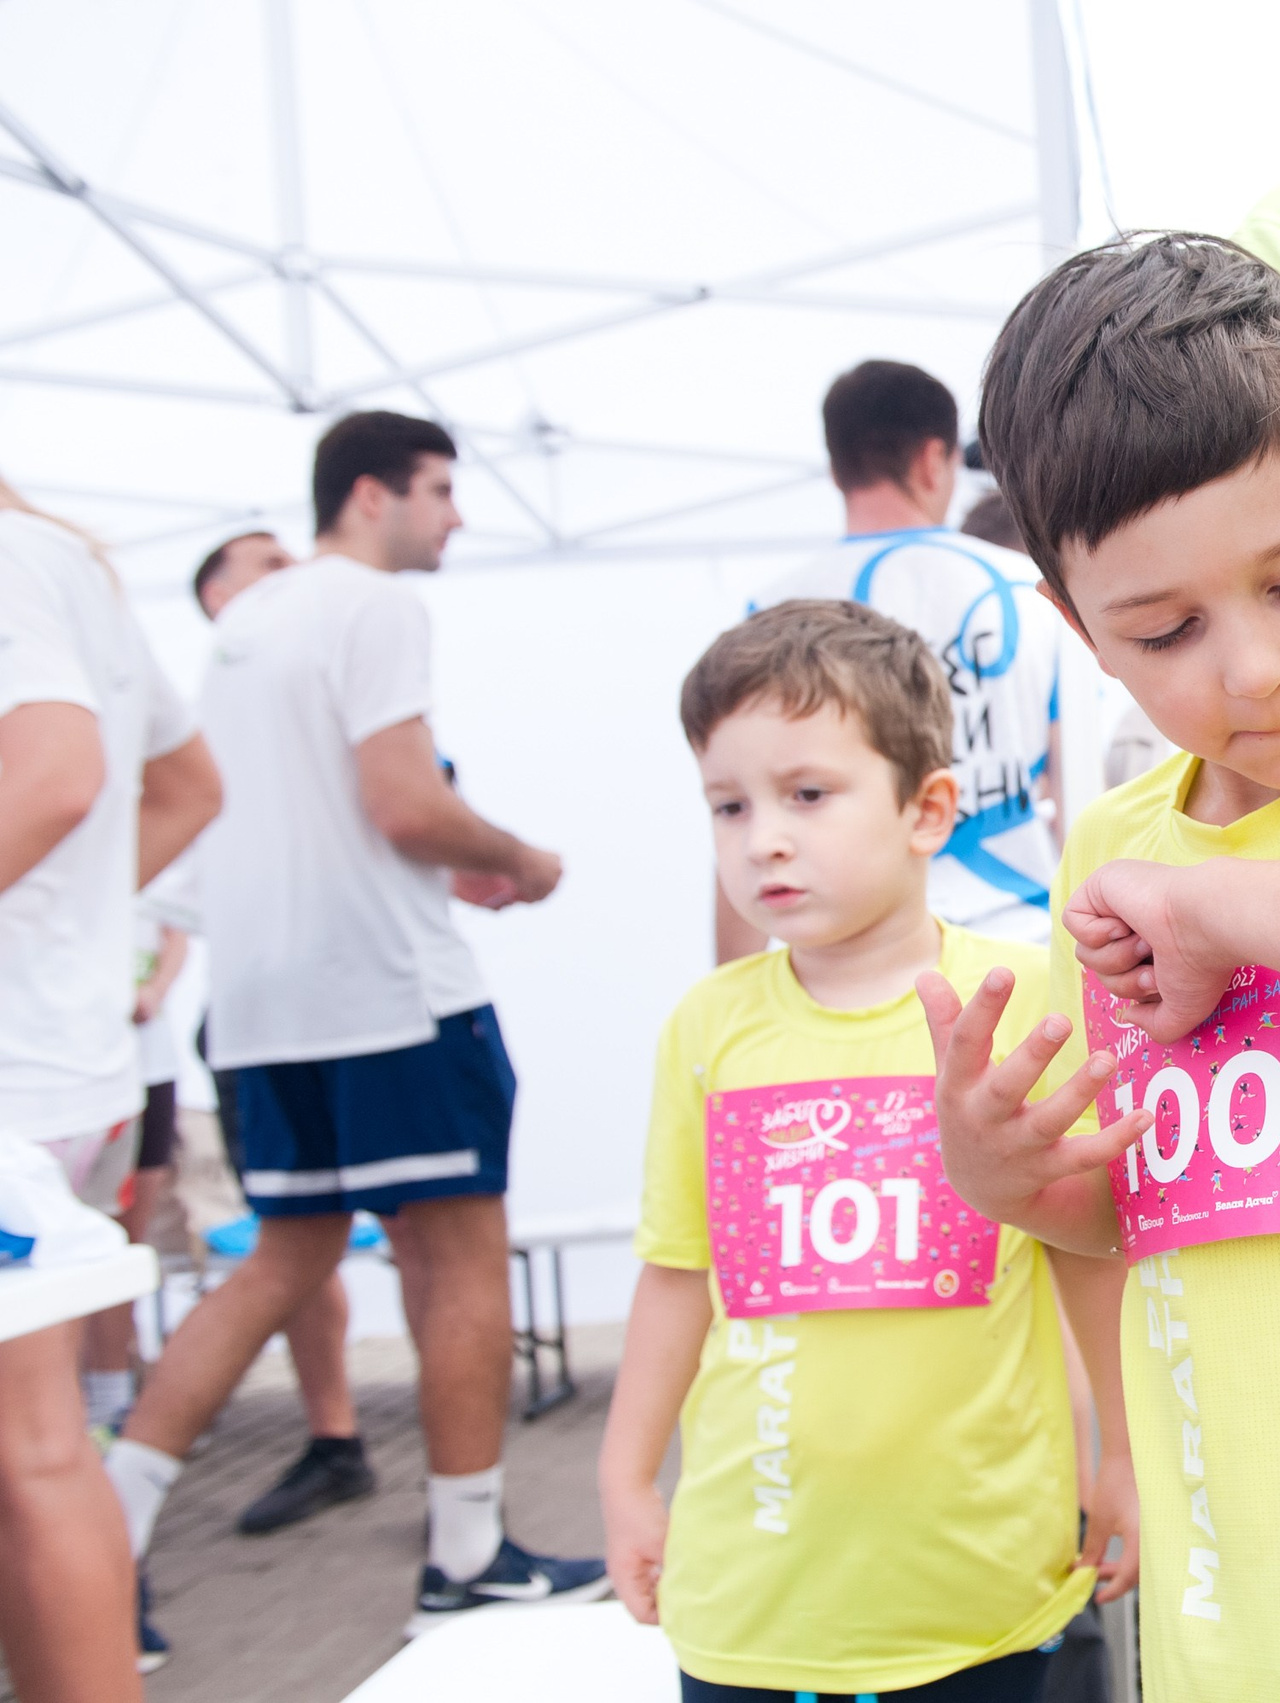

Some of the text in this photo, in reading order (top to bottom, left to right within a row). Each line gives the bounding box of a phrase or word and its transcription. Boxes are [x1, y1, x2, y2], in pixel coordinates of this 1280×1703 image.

[1225, 965, 1257, 992] 023
[769, 1178, 920, 1267] 101
[1215, 1196, 1274, 1212] Белая Дача
[752, 1313, 798, 1535] MARAT
